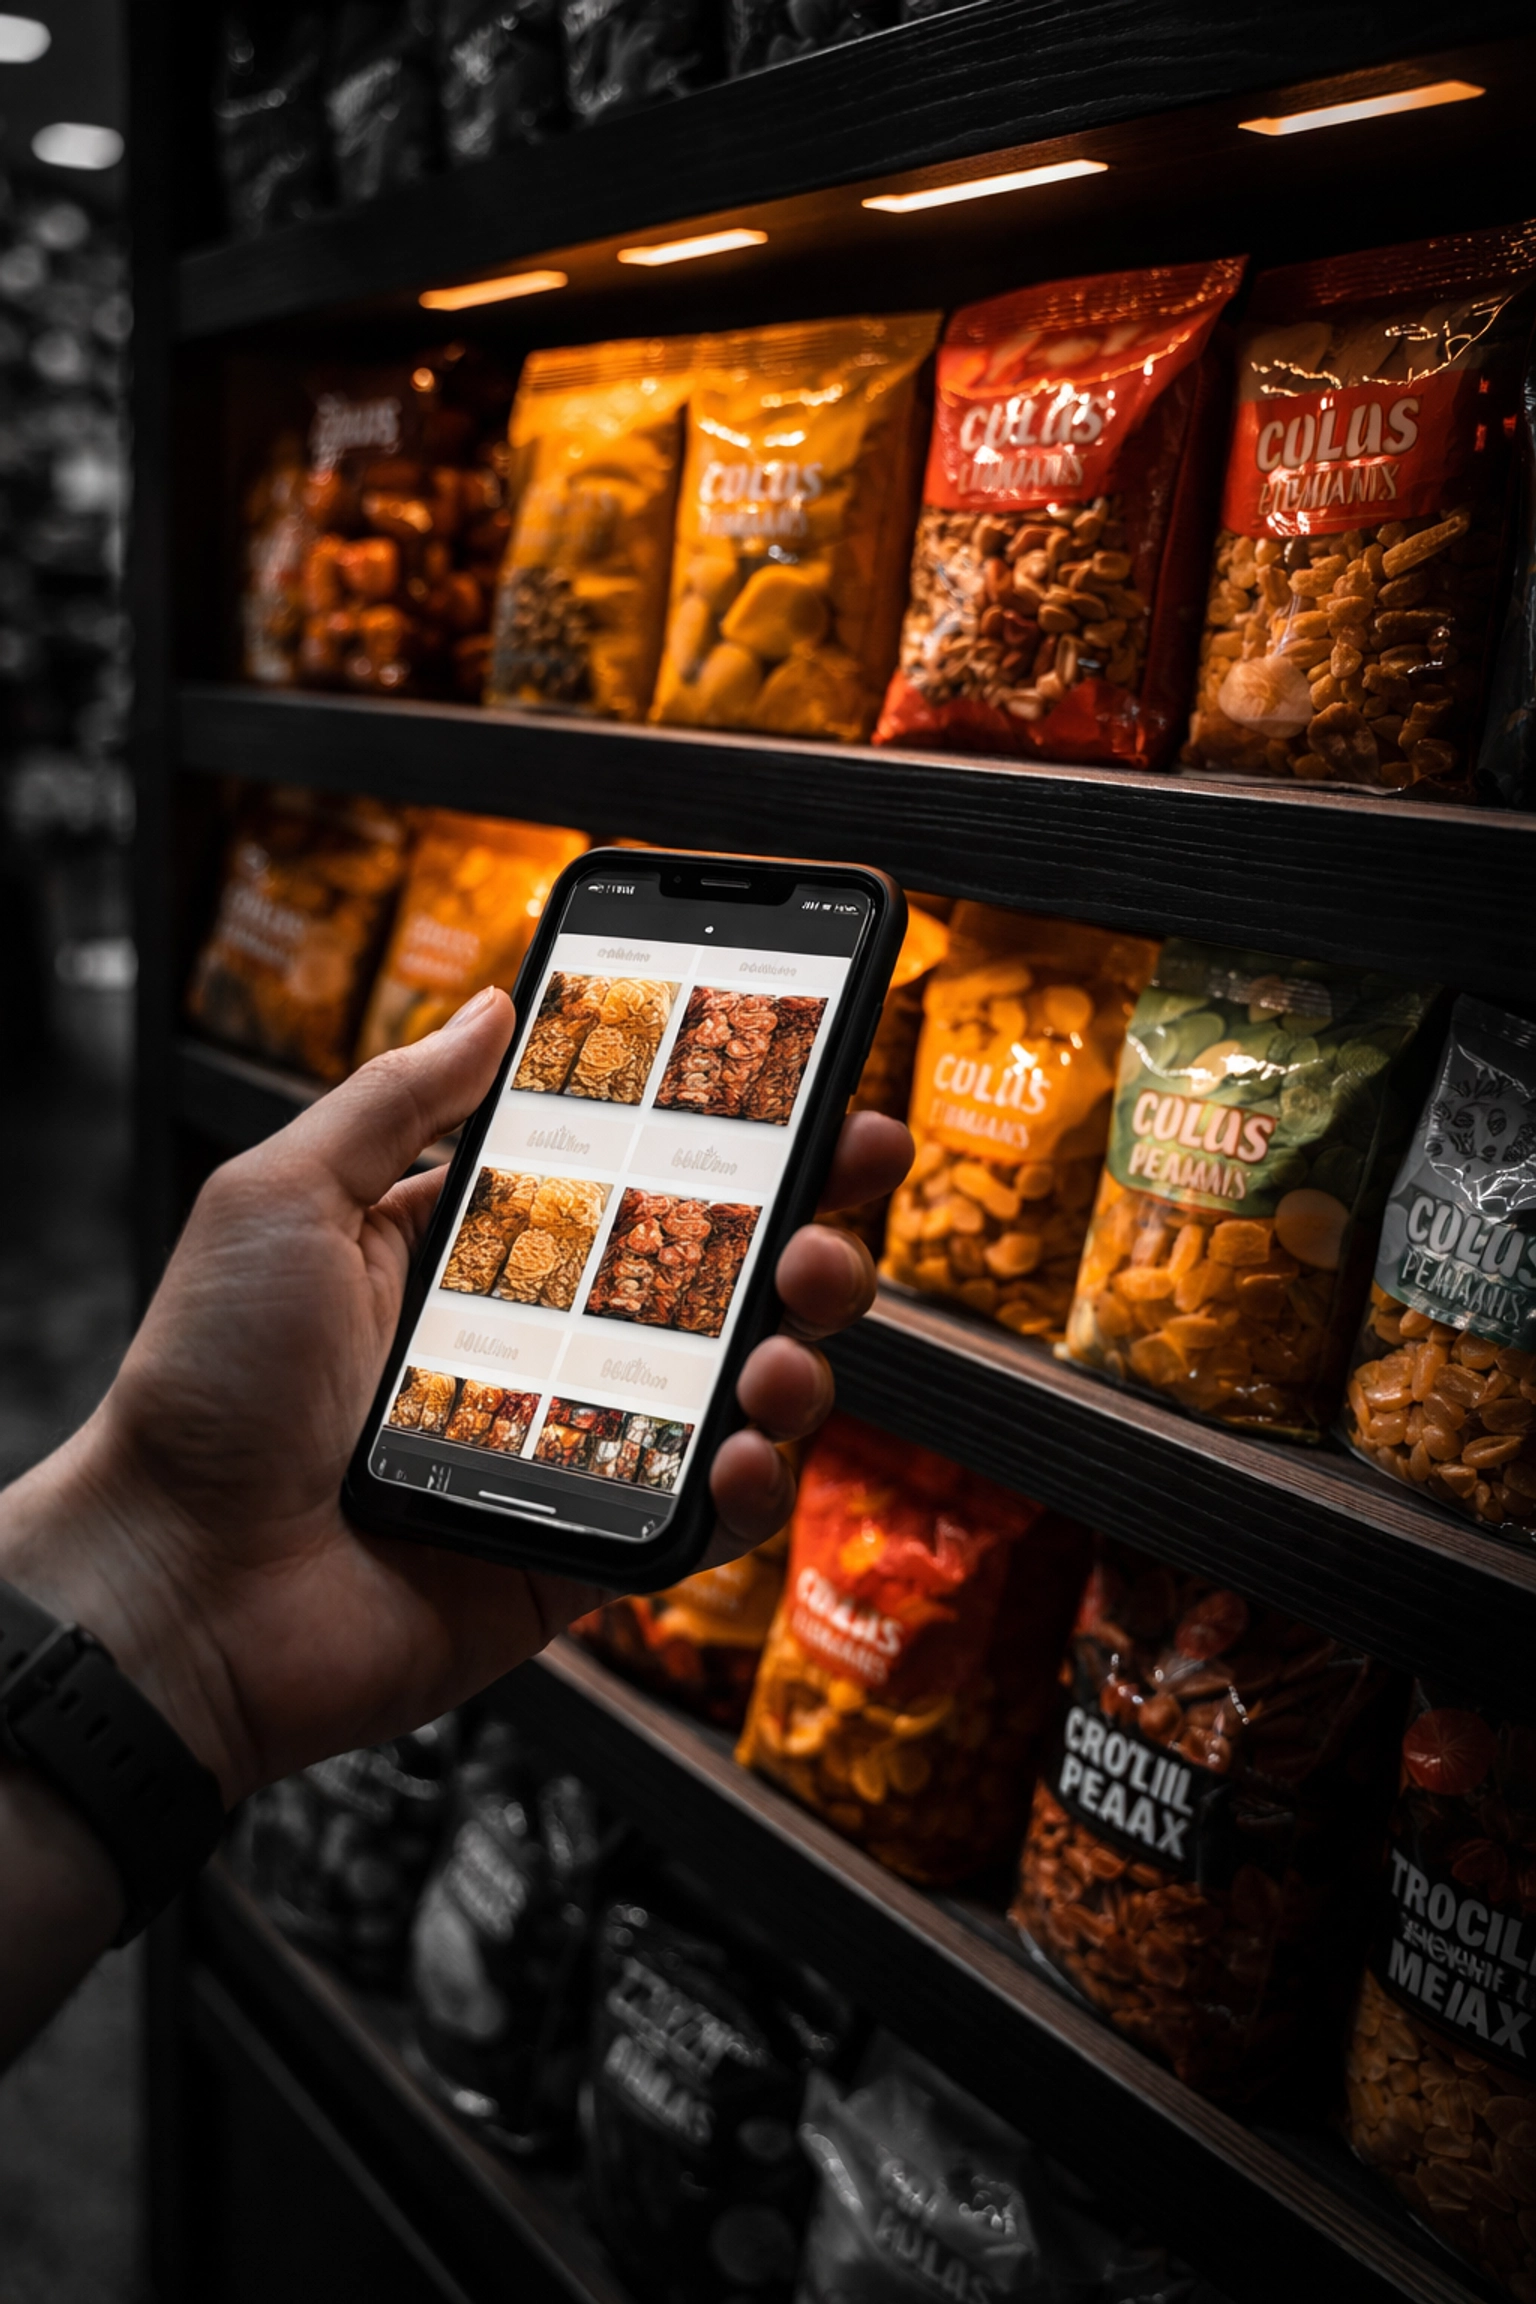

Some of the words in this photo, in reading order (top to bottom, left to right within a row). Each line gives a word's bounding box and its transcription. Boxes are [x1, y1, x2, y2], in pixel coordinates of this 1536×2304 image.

[1132, 1090, 1275, 1163] COLUS
[1059, 1752, 1189, 1861] PEAAX
[1390, 1847, 1536, 1977] TROCIL
